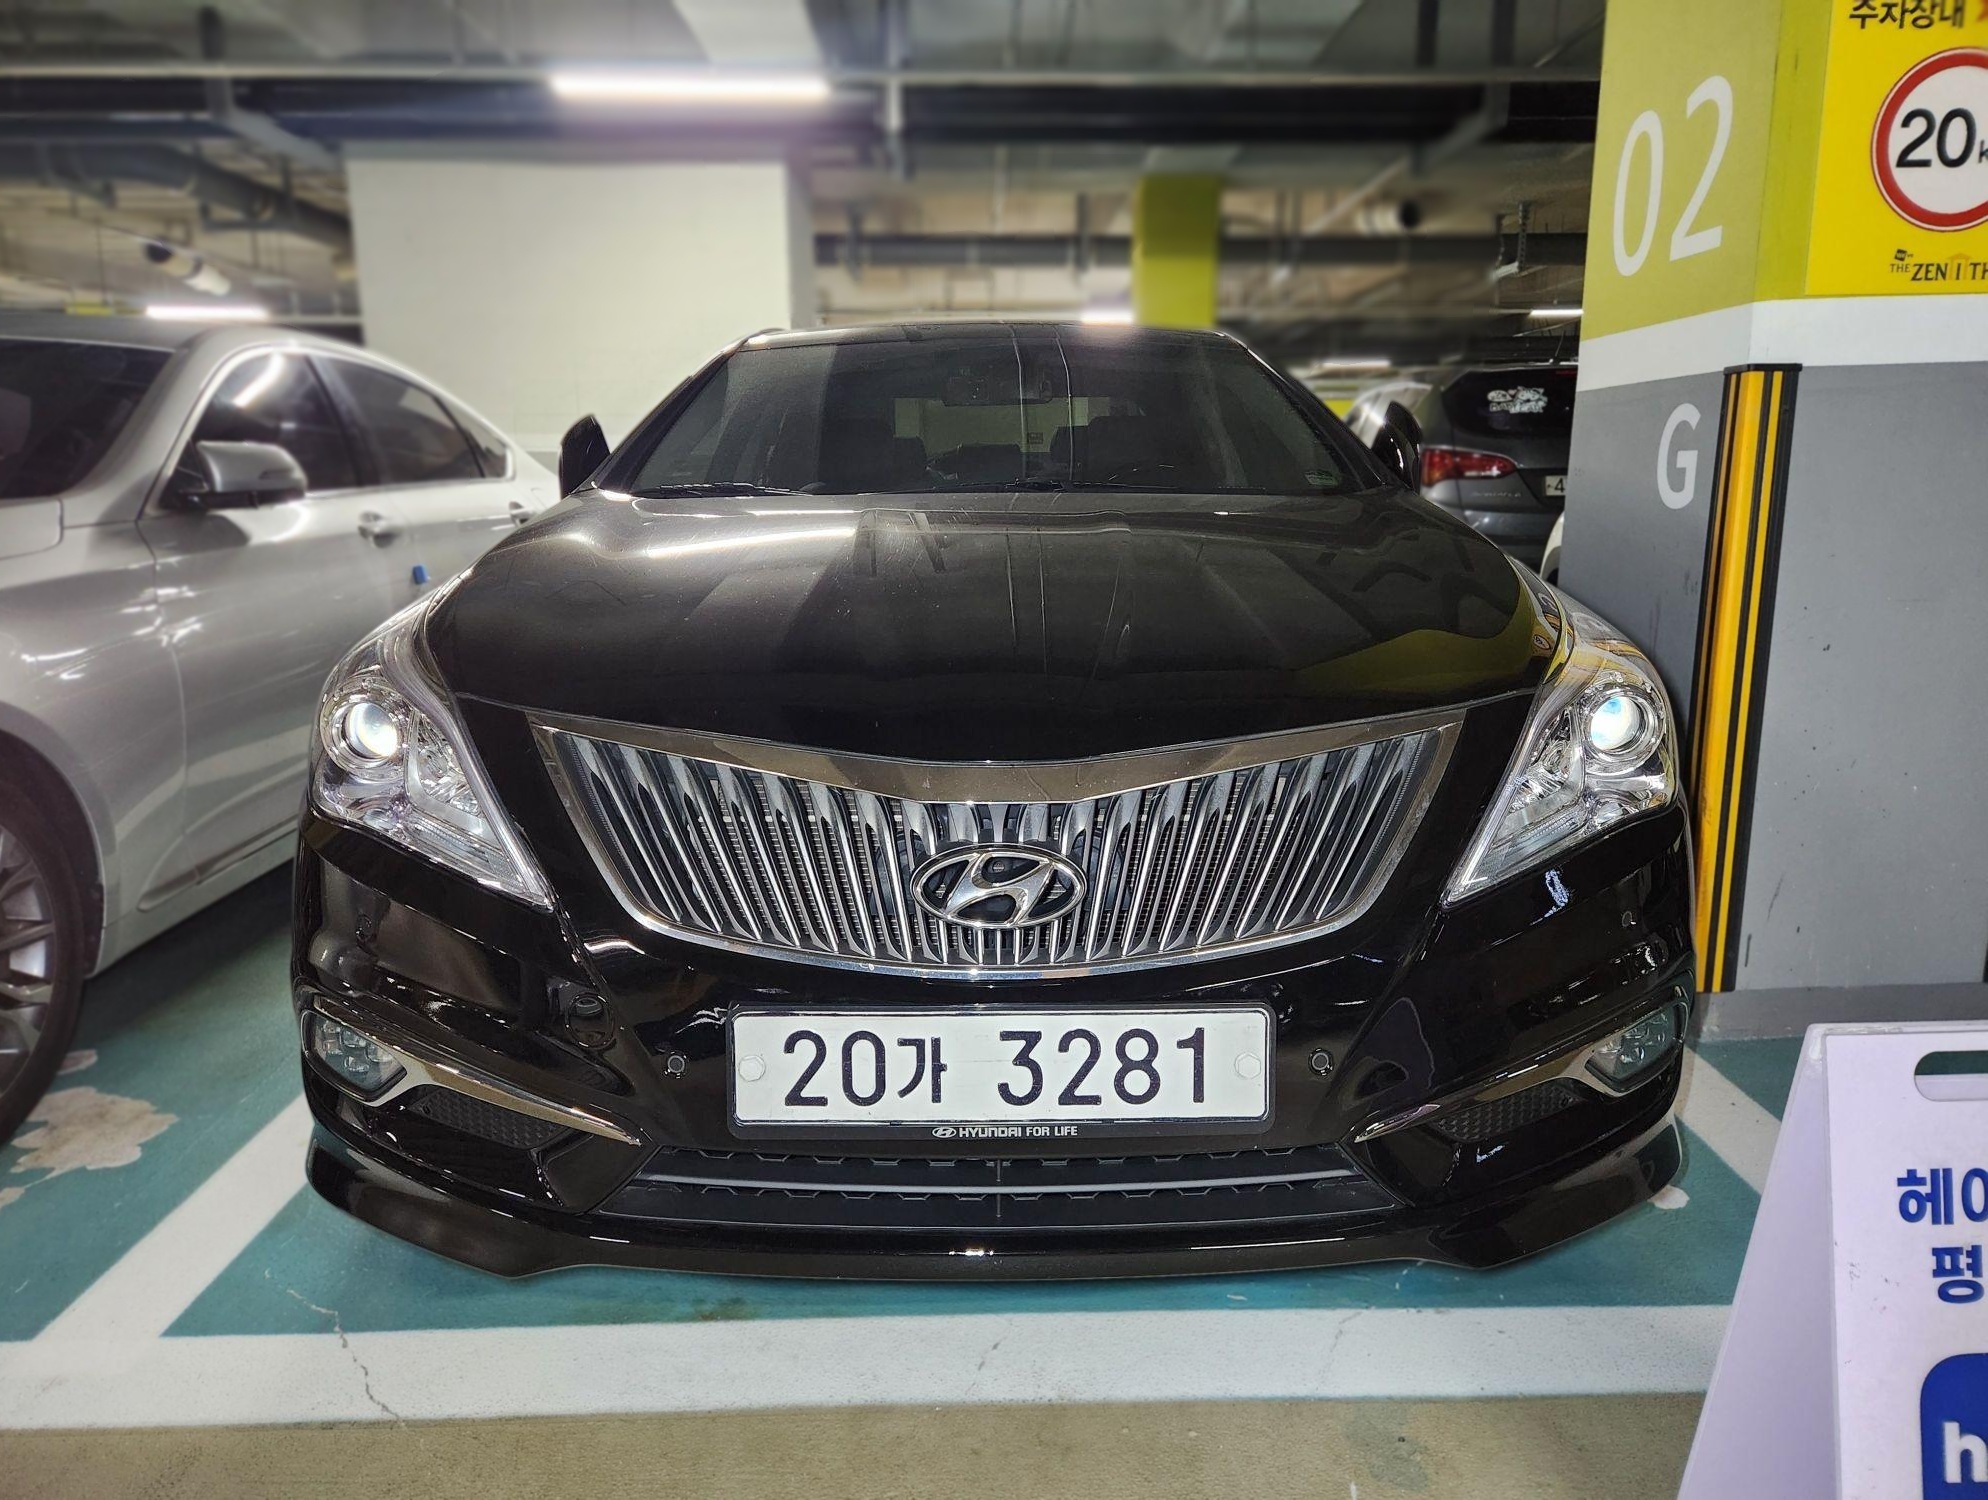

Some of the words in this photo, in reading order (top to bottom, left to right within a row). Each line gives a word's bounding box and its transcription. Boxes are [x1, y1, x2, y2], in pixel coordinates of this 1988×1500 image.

[1613, 75, 1734, 277] 02
[1890, 263, 1911, 273] THE
[1657, 403, 1701, 509] G
[784, 1029, 947, 1107] 20가
[998, 1027, 1205, 1106] 3281
[959, 1126, 1022, 1138] HYUNDAI
[1026, 1126, 1050, 1137] FOR
[1054, 1125, 1078, 1137] LIFE
[1932, 1244, 1985, 1304] 평
[1943, 1421, 1988, 1484] h
